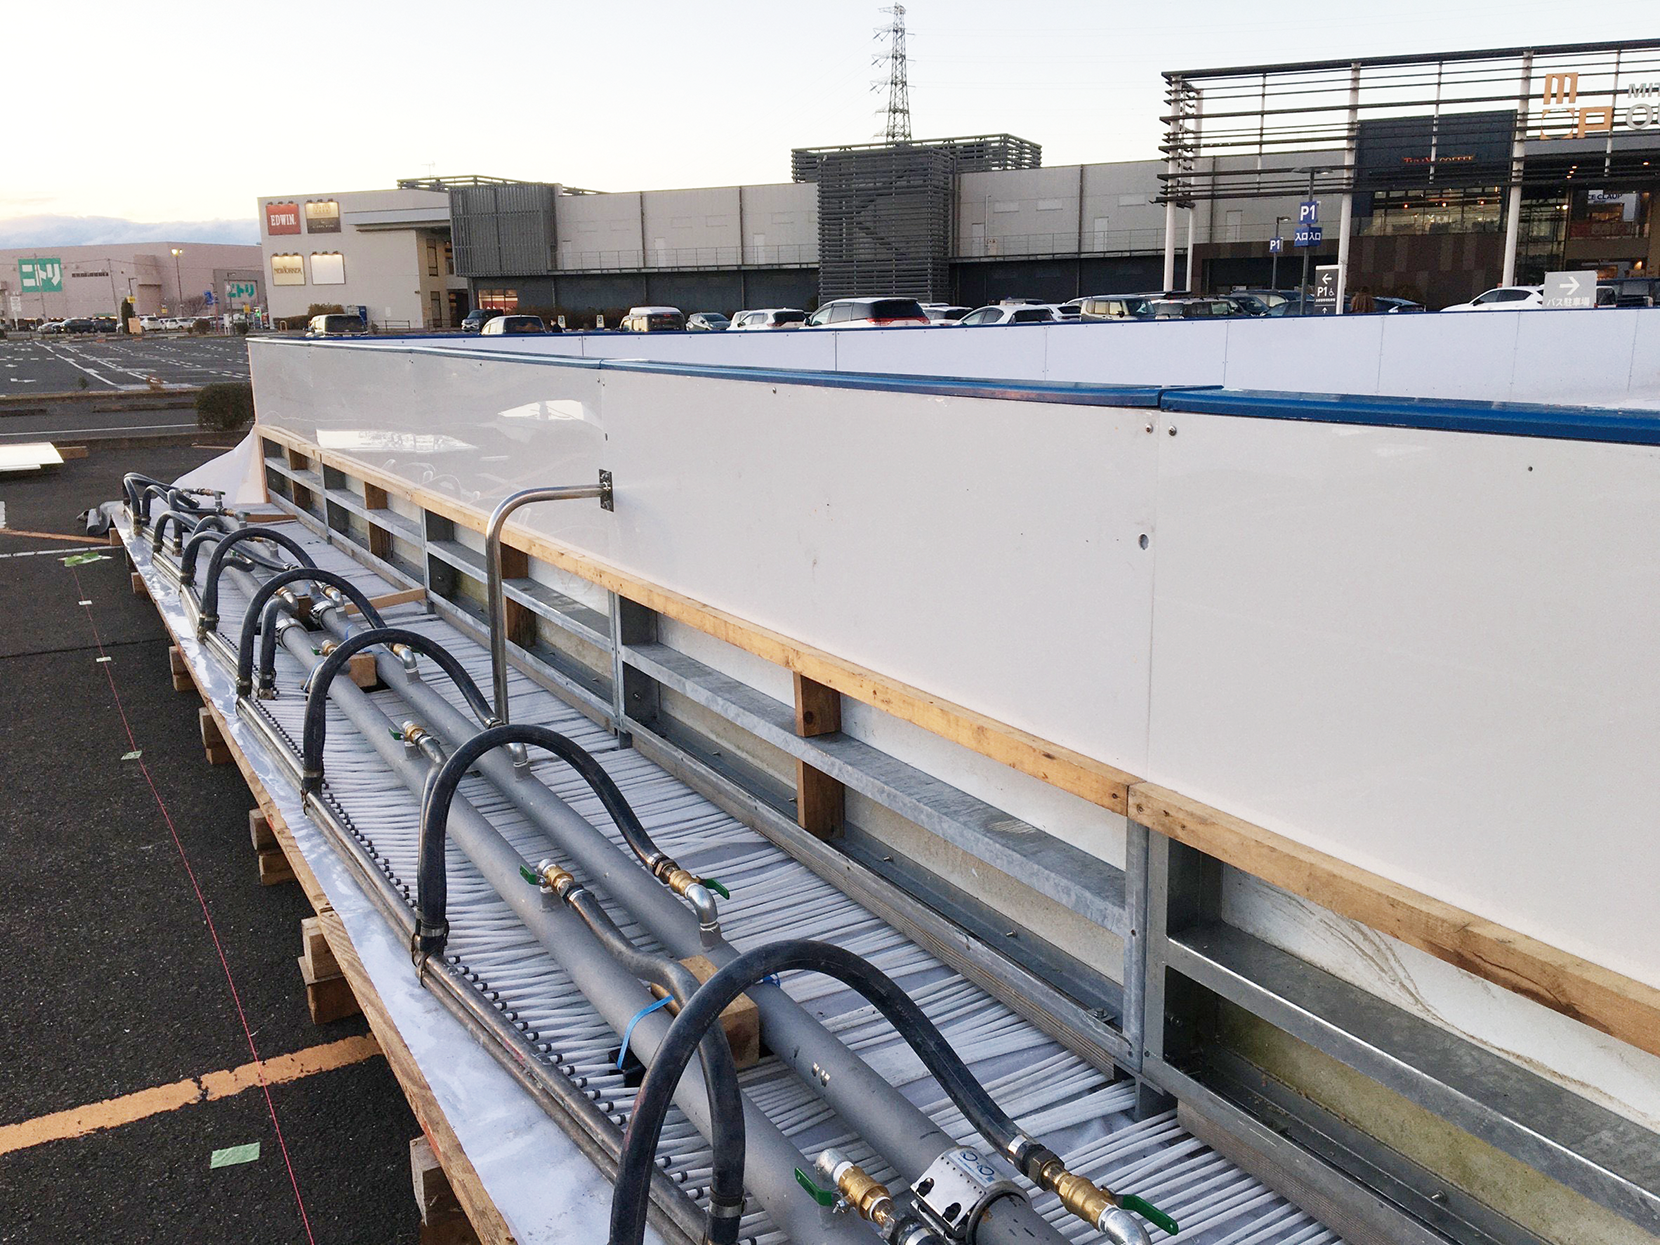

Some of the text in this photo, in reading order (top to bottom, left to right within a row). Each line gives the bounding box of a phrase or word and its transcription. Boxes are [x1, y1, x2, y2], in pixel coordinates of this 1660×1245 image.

[1626, 103, 1660, 130] O
[1300, 204, 1316, 221] P1
[1269, 239, 1280, 250] P1
[21, 263, 61, 287] ニトリ
[1317, 286, 1328, 297] P1
